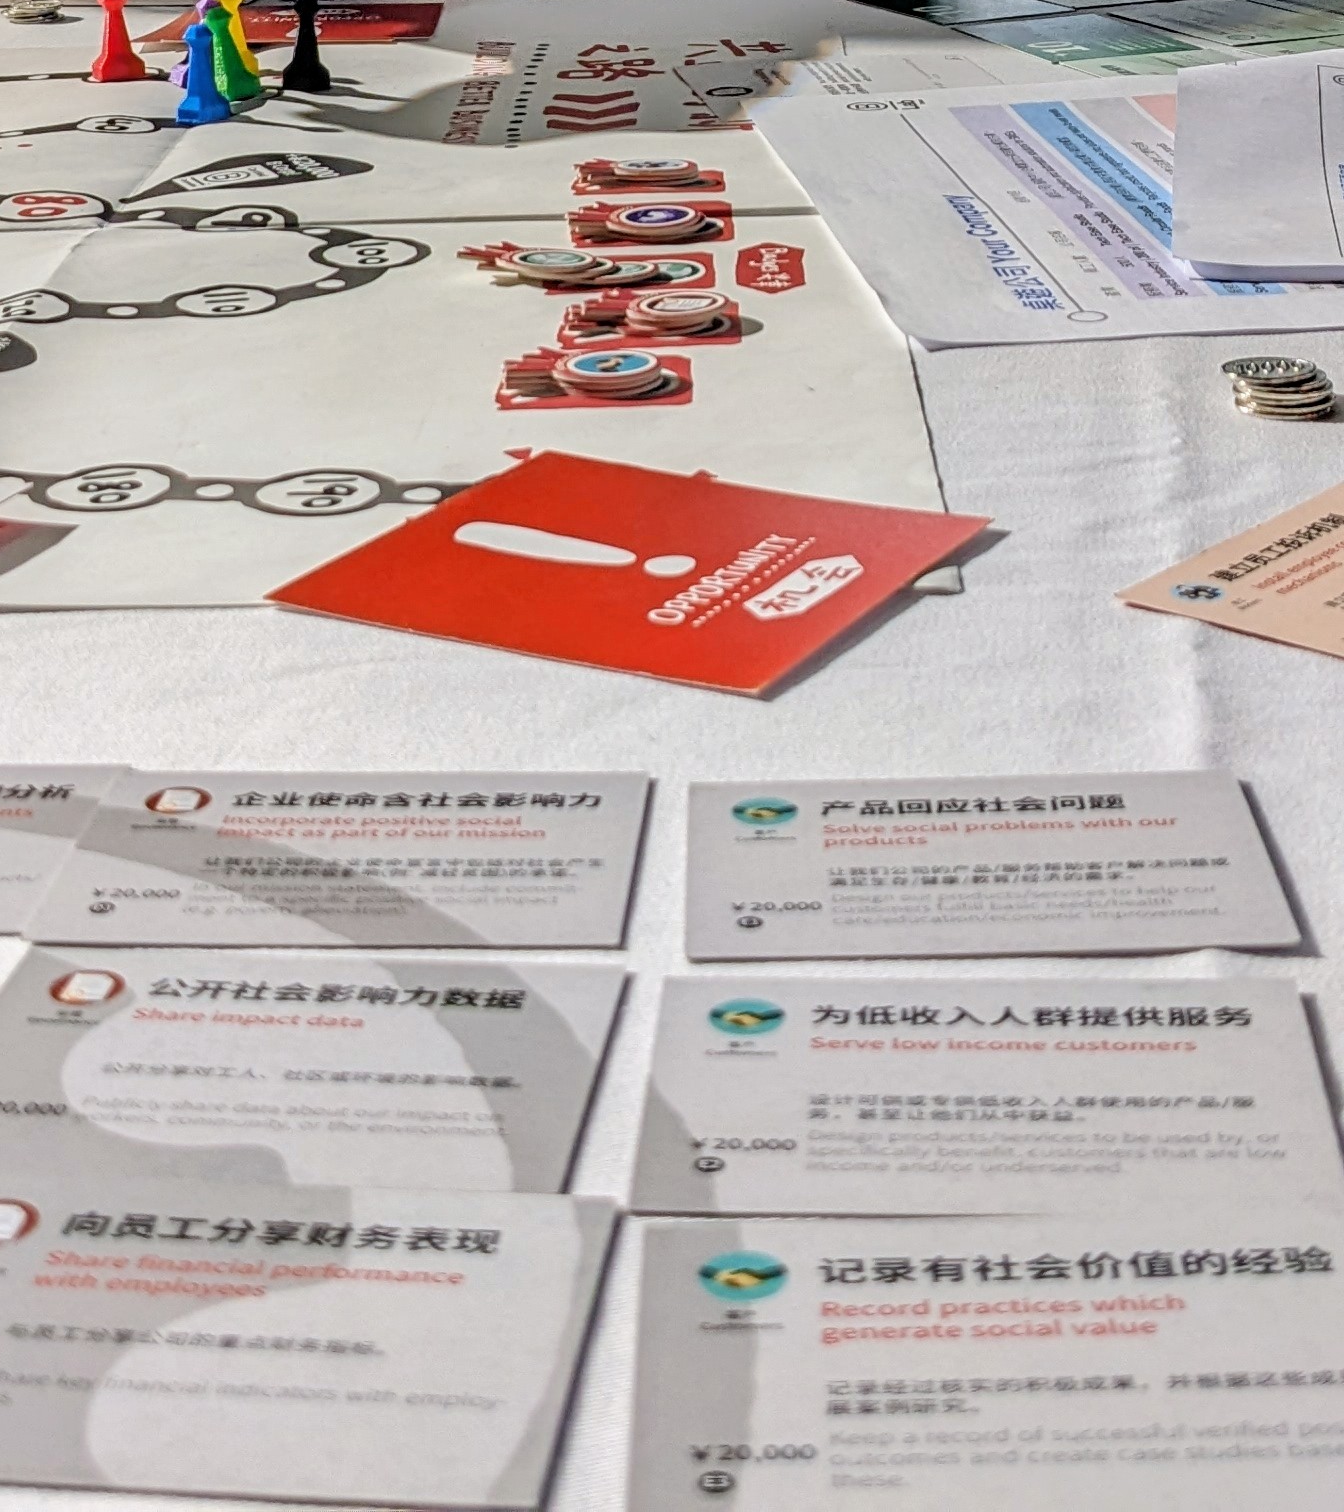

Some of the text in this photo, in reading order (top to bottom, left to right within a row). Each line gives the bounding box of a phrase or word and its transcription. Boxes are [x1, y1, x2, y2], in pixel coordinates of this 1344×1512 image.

[12, 194, 88, 217] 80
[81, 469, 144, 504] 180
[287, 476, 359, 508] 190
[648, 534, 798, 626] OPPORTUNITY
[232, 791, 602, 807] 企业使命含社会影响力
[819, 794, 1126, 817] 产品回应社会问题
[222, 814, 522, 826] Incorporate positive social
[823, 822, 885, 833] Solve
[891, 821, 958, 832] social
[964, 818, 1075, 833] problems
[1080, 817, 1132, 827] with
[216, 827, 294, 838] impact
[331, 827, 380, 838] part
[456, 827, 546, 837] mission
[824, 835, 927, 848] products
[731, 900, 822, 912] ¥20,000
[147, 977, 526, 1009] 公开社会影响力数据
[132, 1008, 364, 1027] Share impact data
[810, 1005, 1254, 1027] 为低收入人群提供服务
[810, 1036, 1198, 1051] Serve low income customers
[60, 1210, 502, 1254] 向员工分享财务表现
[46, 1250, 129, 1269] Share
[136, 1253, 265, 1278] financial
[816, 1245, 1335, 1285] 记录有社会价值的经验
[33, 1273, 267, 1298] with employees
[820, 1294, 1186, 1318] Record practices which
[820, 1318, 1159, 1345] generate social value
[689, 1442, 818, 1462] ¥20,000
